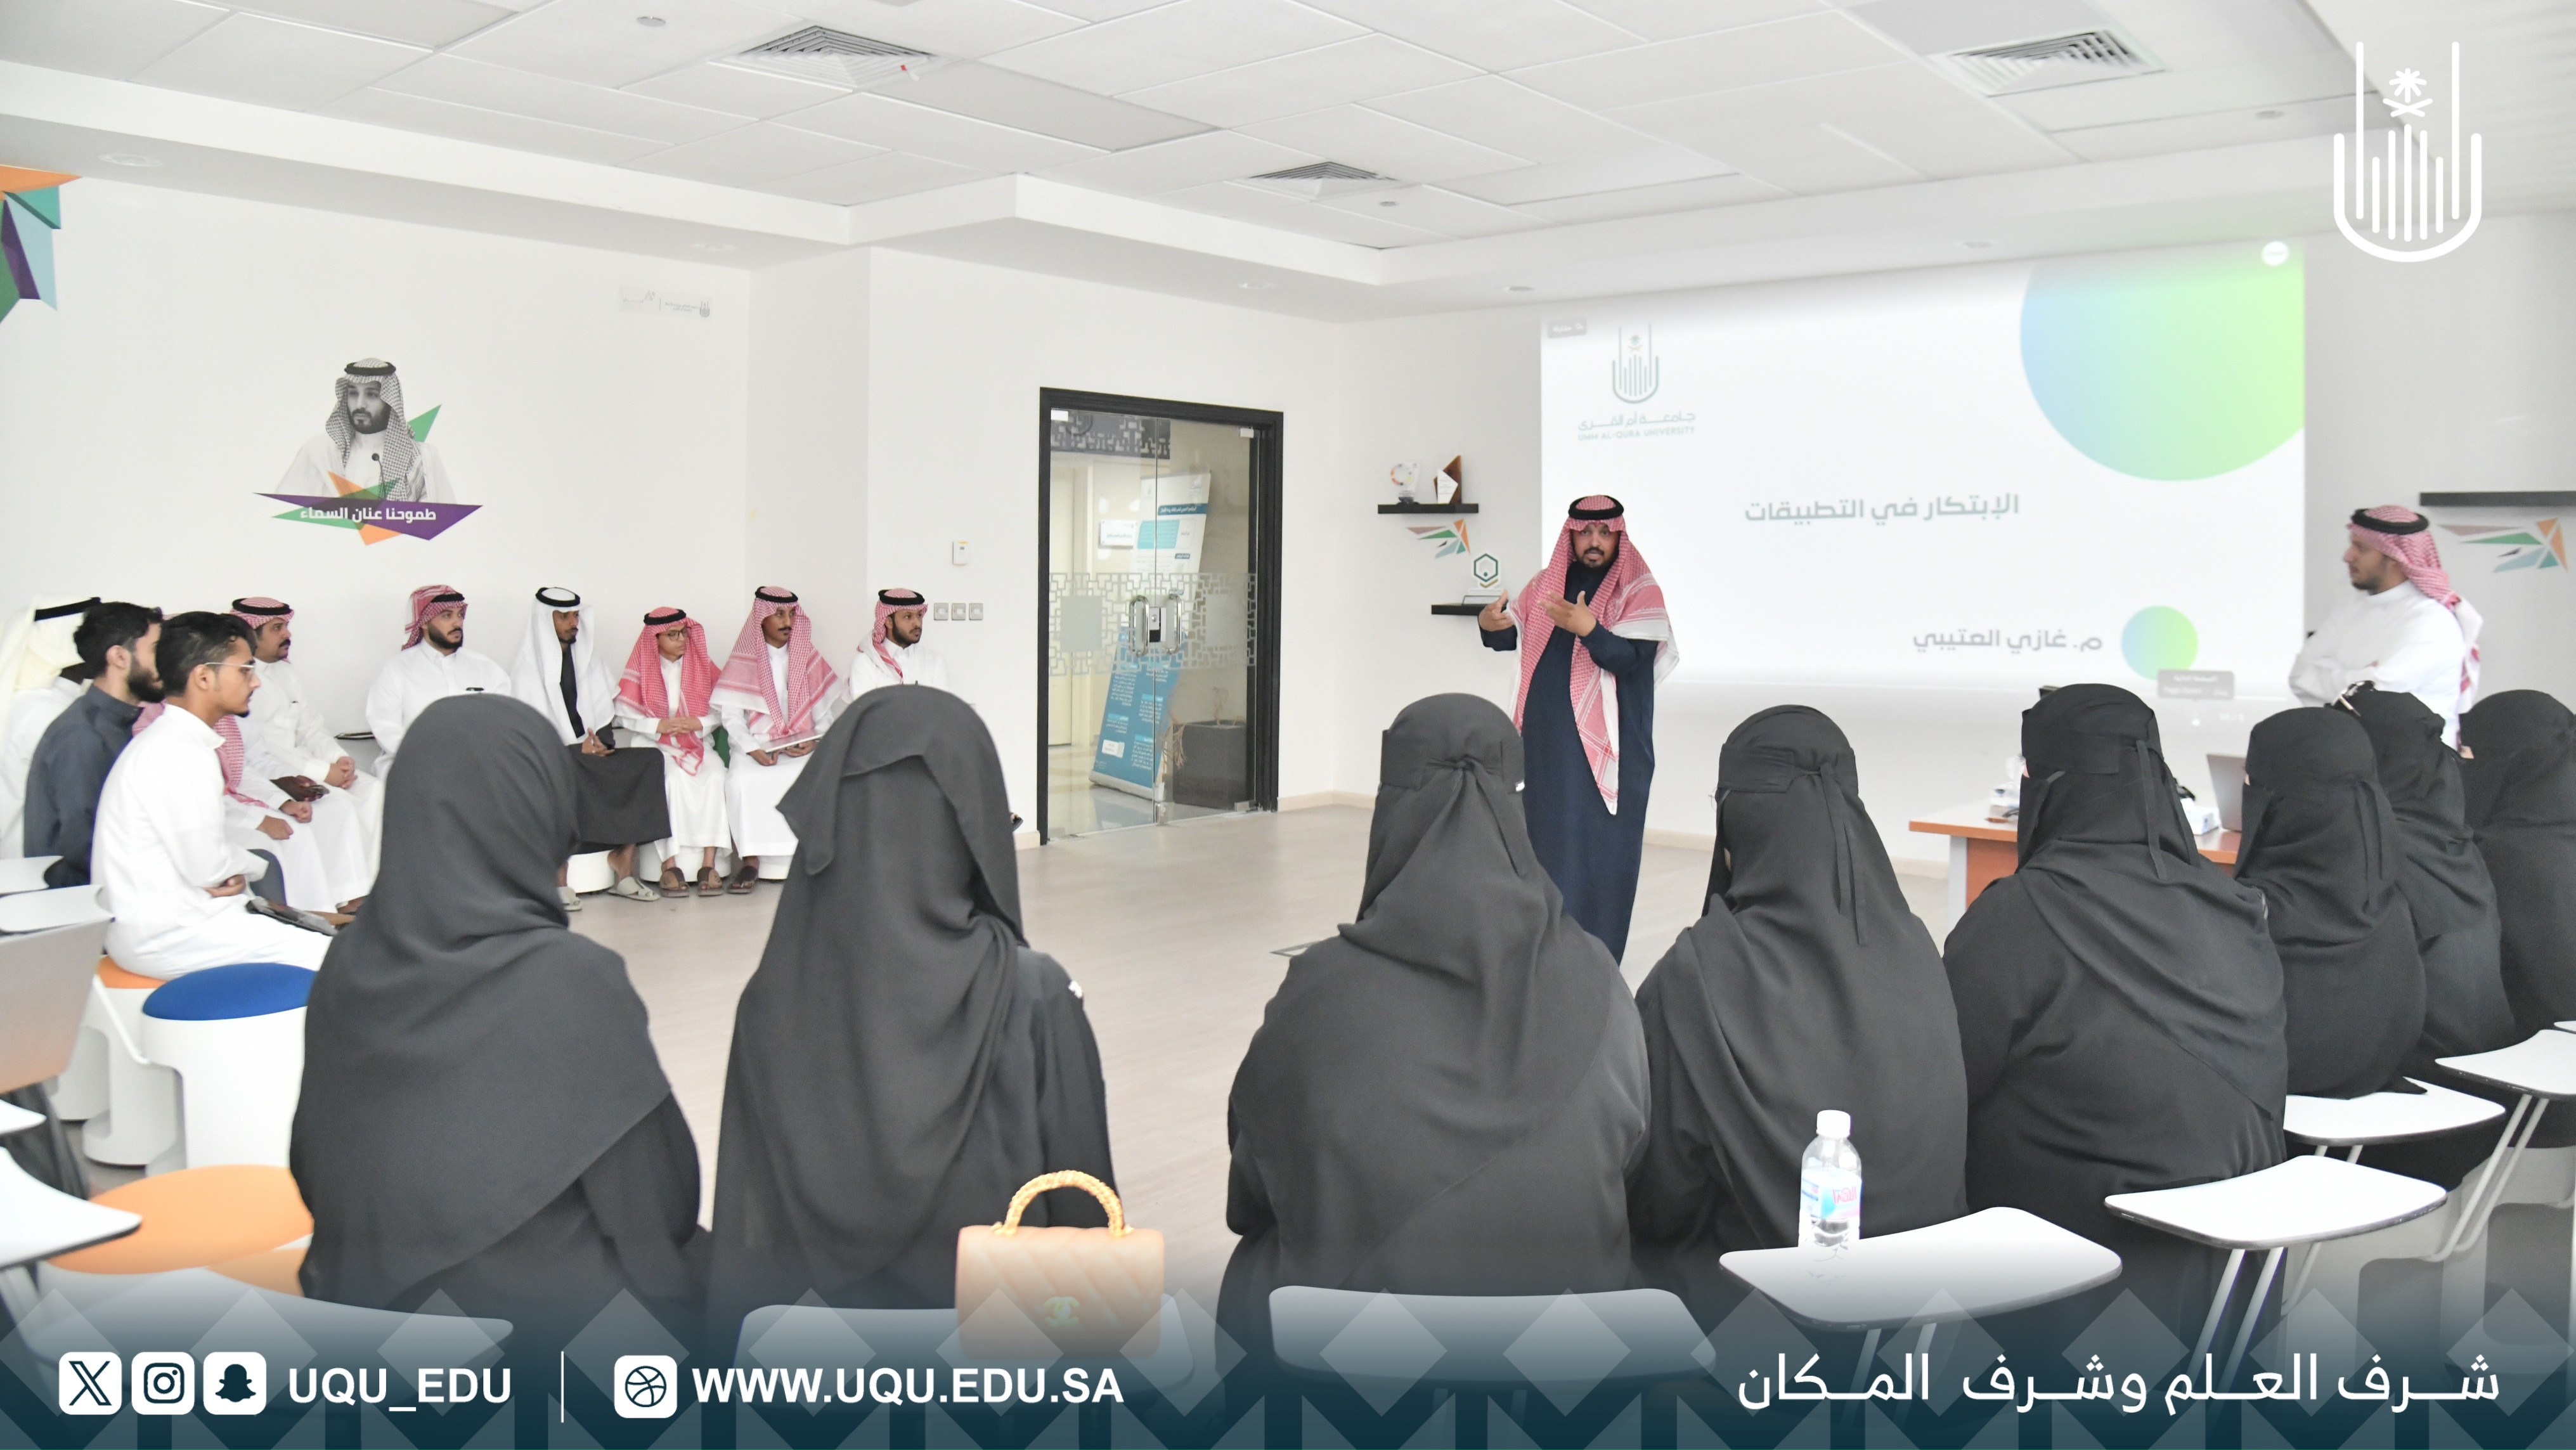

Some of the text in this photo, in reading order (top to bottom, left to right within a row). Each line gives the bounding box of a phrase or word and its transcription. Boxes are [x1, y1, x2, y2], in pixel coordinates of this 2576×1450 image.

[1578, 426, 1695, 442] UMM AL-QURA UNIVERSITY
[301, 507, 436, 524] طموحنا عنان السماء
[1744, 499, 1864, 526] التطبيقات
[1871, 498, 1919, 526] في
[1912, 629, 2103, 654] م. غازي العتيبي
